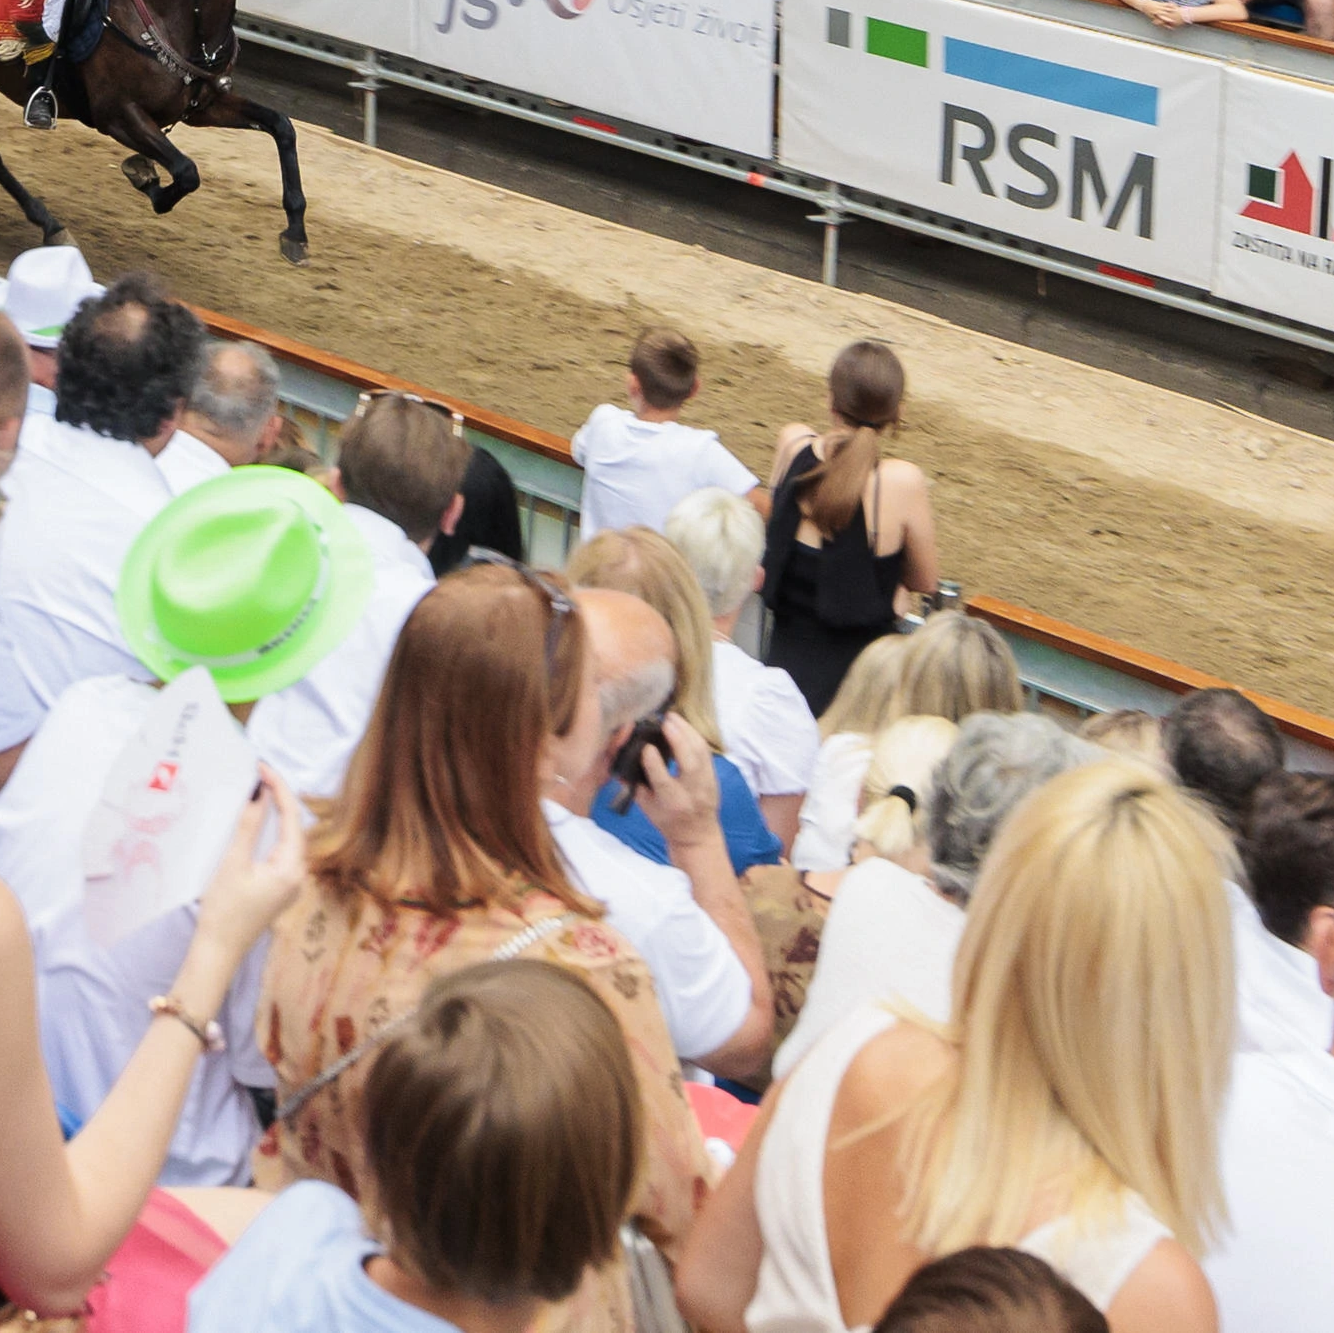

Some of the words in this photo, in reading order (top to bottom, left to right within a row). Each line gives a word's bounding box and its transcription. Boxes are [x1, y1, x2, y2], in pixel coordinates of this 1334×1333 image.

[692, 4, 765, 48] život
[939, 102, 1157, 242] RSM
[1231, 229, 1294, 261] ZAŠTITA
[1297, 248, 1318, 269] NA
